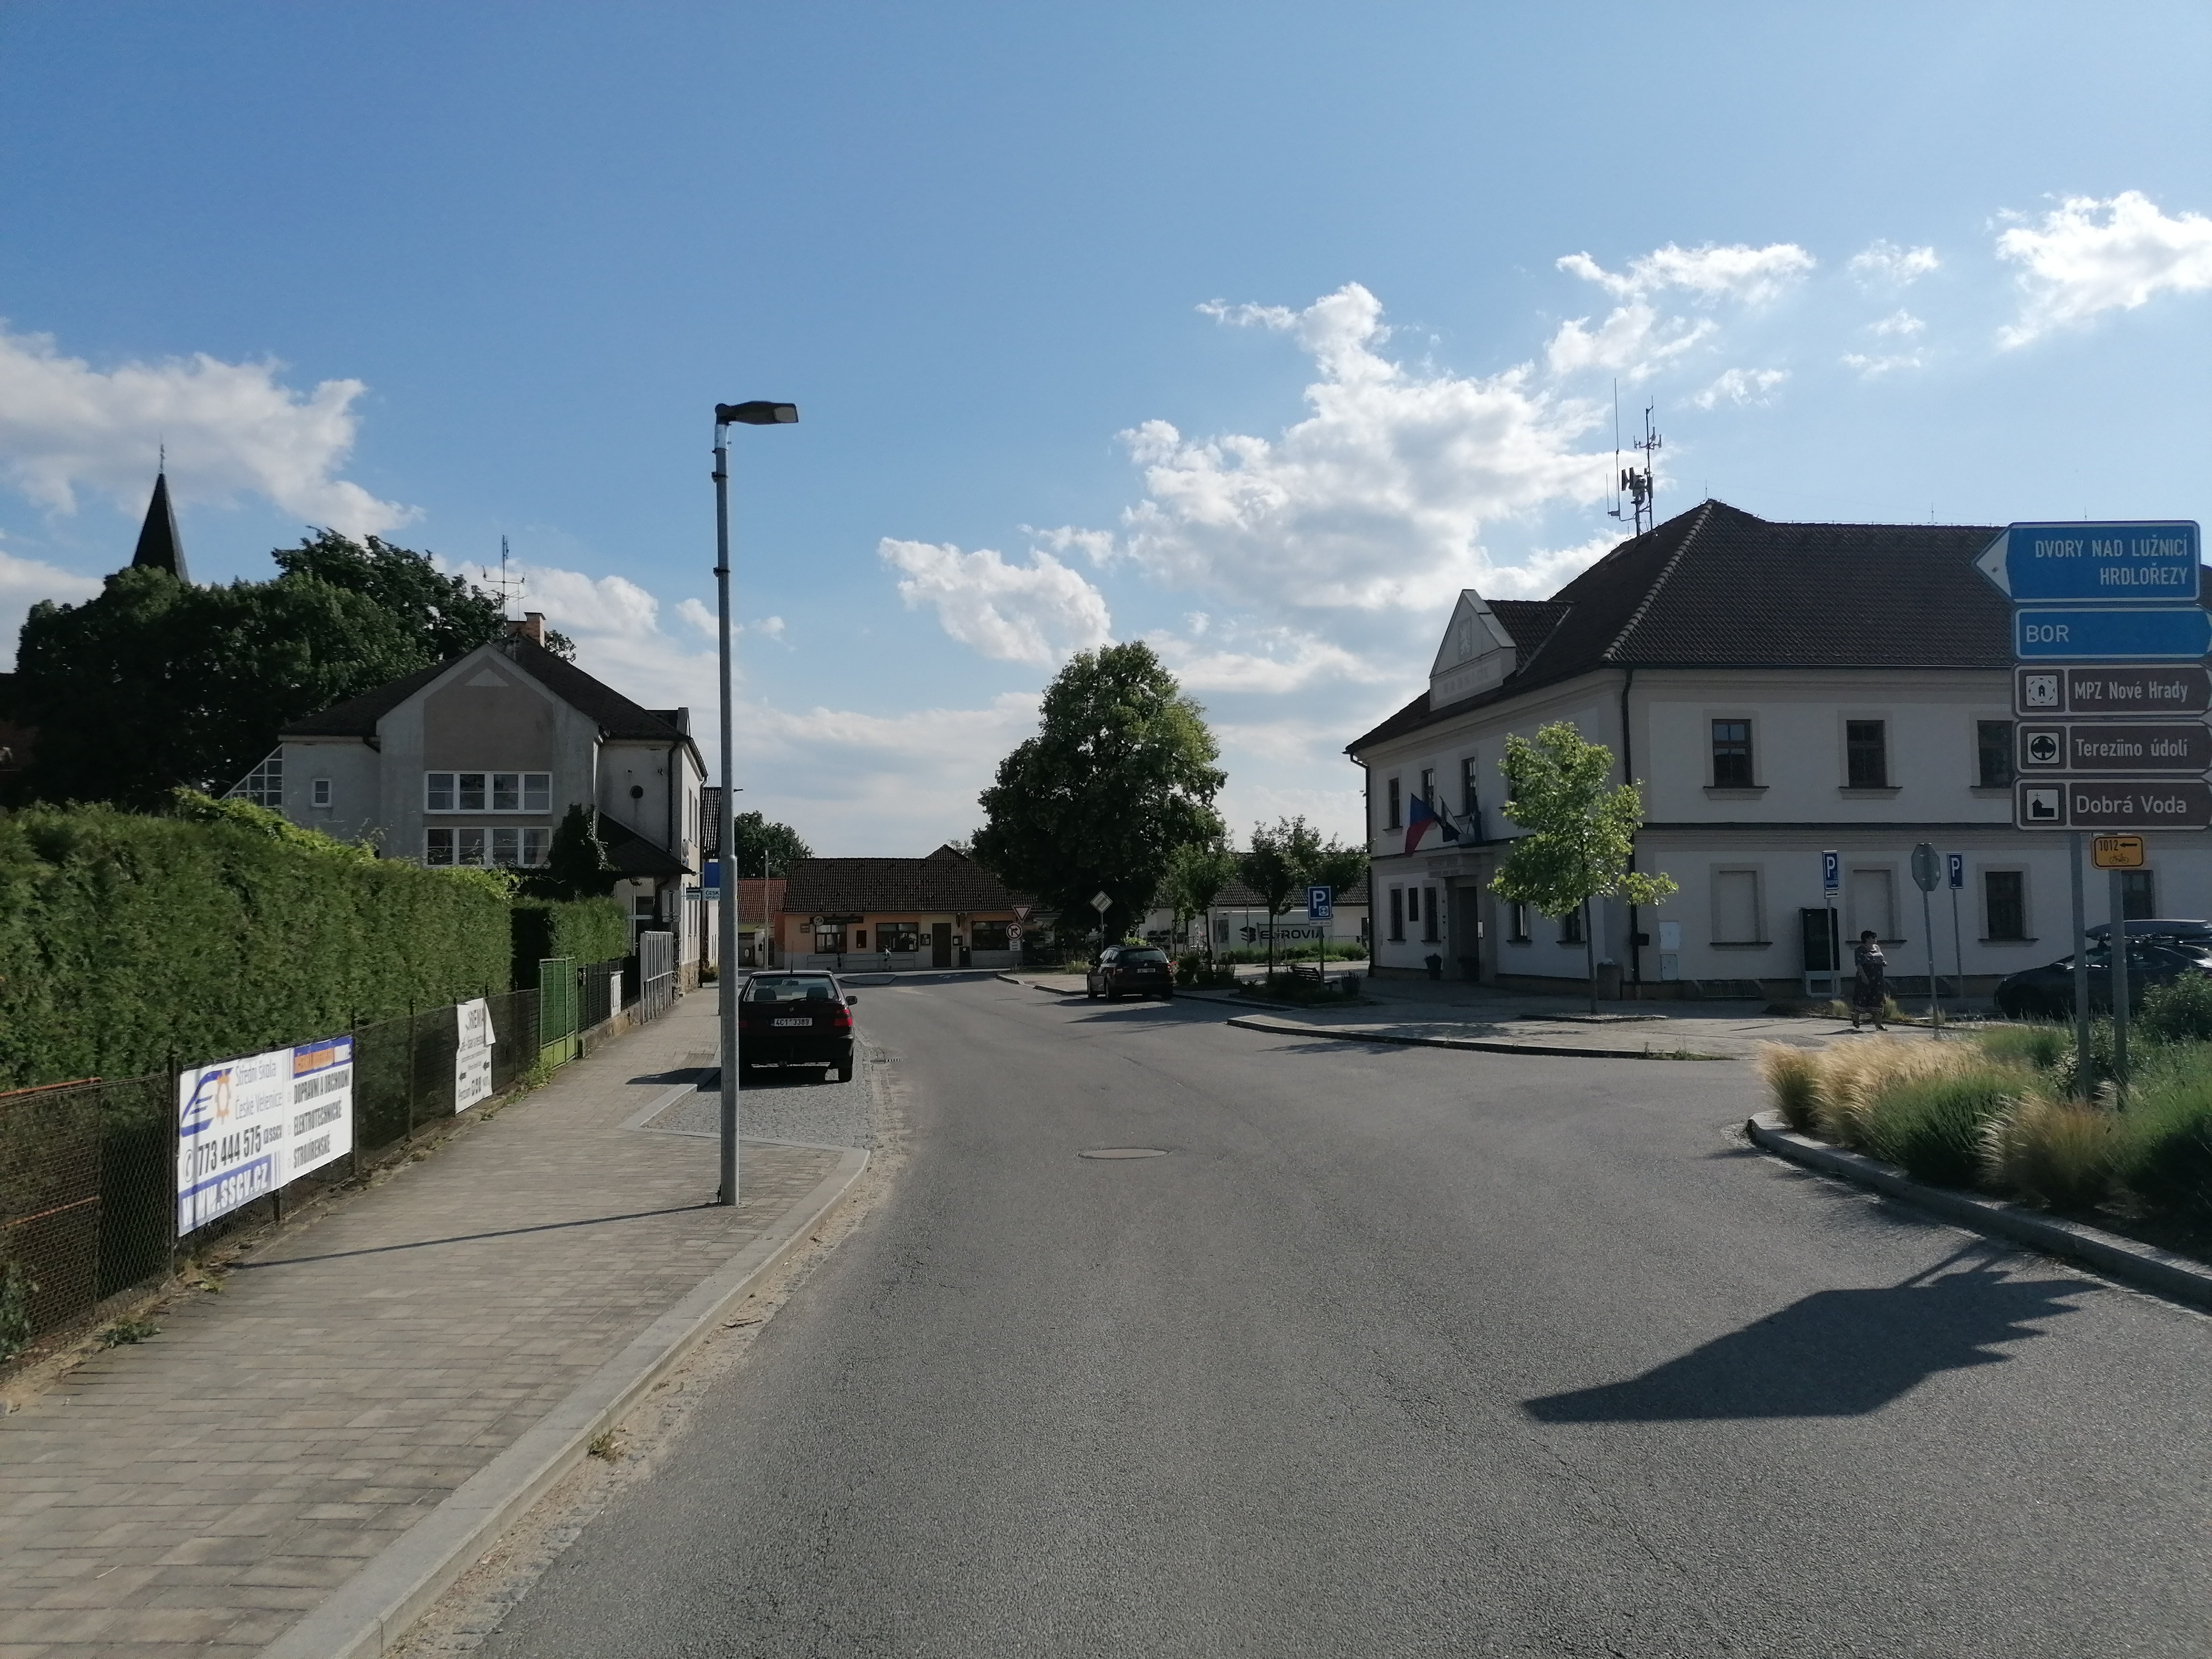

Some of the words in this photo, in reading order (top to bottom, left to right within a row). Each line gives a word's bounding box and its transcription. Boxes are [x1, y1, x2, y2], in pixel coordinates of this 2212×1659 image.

[2035, 539, 2084, 558] DVORY
[2091, 539, 2124, 557] NAD
[2131, 533, 2188, 557] LUŽNICÍ
[2100, 562, 2188, 586] HRDLOŘEZY
[2025, 624, 2069, 643] BOR
[2074, 681, 2102, 700] MPZ
[2109, 680, 2143, 700] Nové
[2148, 681, 2188, 703] Hrady
[2151, 739, 2188, 757] údolí
[2076, 795, 2133, 815] Dobrá
[2141, 795, 2188, 813] Voda
[2099, 839, 2118, 851] 1012
[1827, 856, 1835, 878] P
[1951, 857, 1960, 878] P
[1313, 890, 1326, 909] P
[1260, 930, 1324, 939] EROVIA
[236, 1062, 257, 1087] Střední
[259, 1058, 276, 1080] škola
[294, 1073, 319, 1104] DOPRAVNÍ
[235, 1094, 254, 1120] České
[255, 1089, 283, 1113] Velenice
[294, 1096, 342, 1138] ELEKTROTECHNICKÉ
[197, 1140, 217, 1176] 773
[221, 1131, 240, 1166] 444
[243, 1124, 261, 1157] 575
[294, 1130, 331, 1169] STROJÍRENSKÉ
